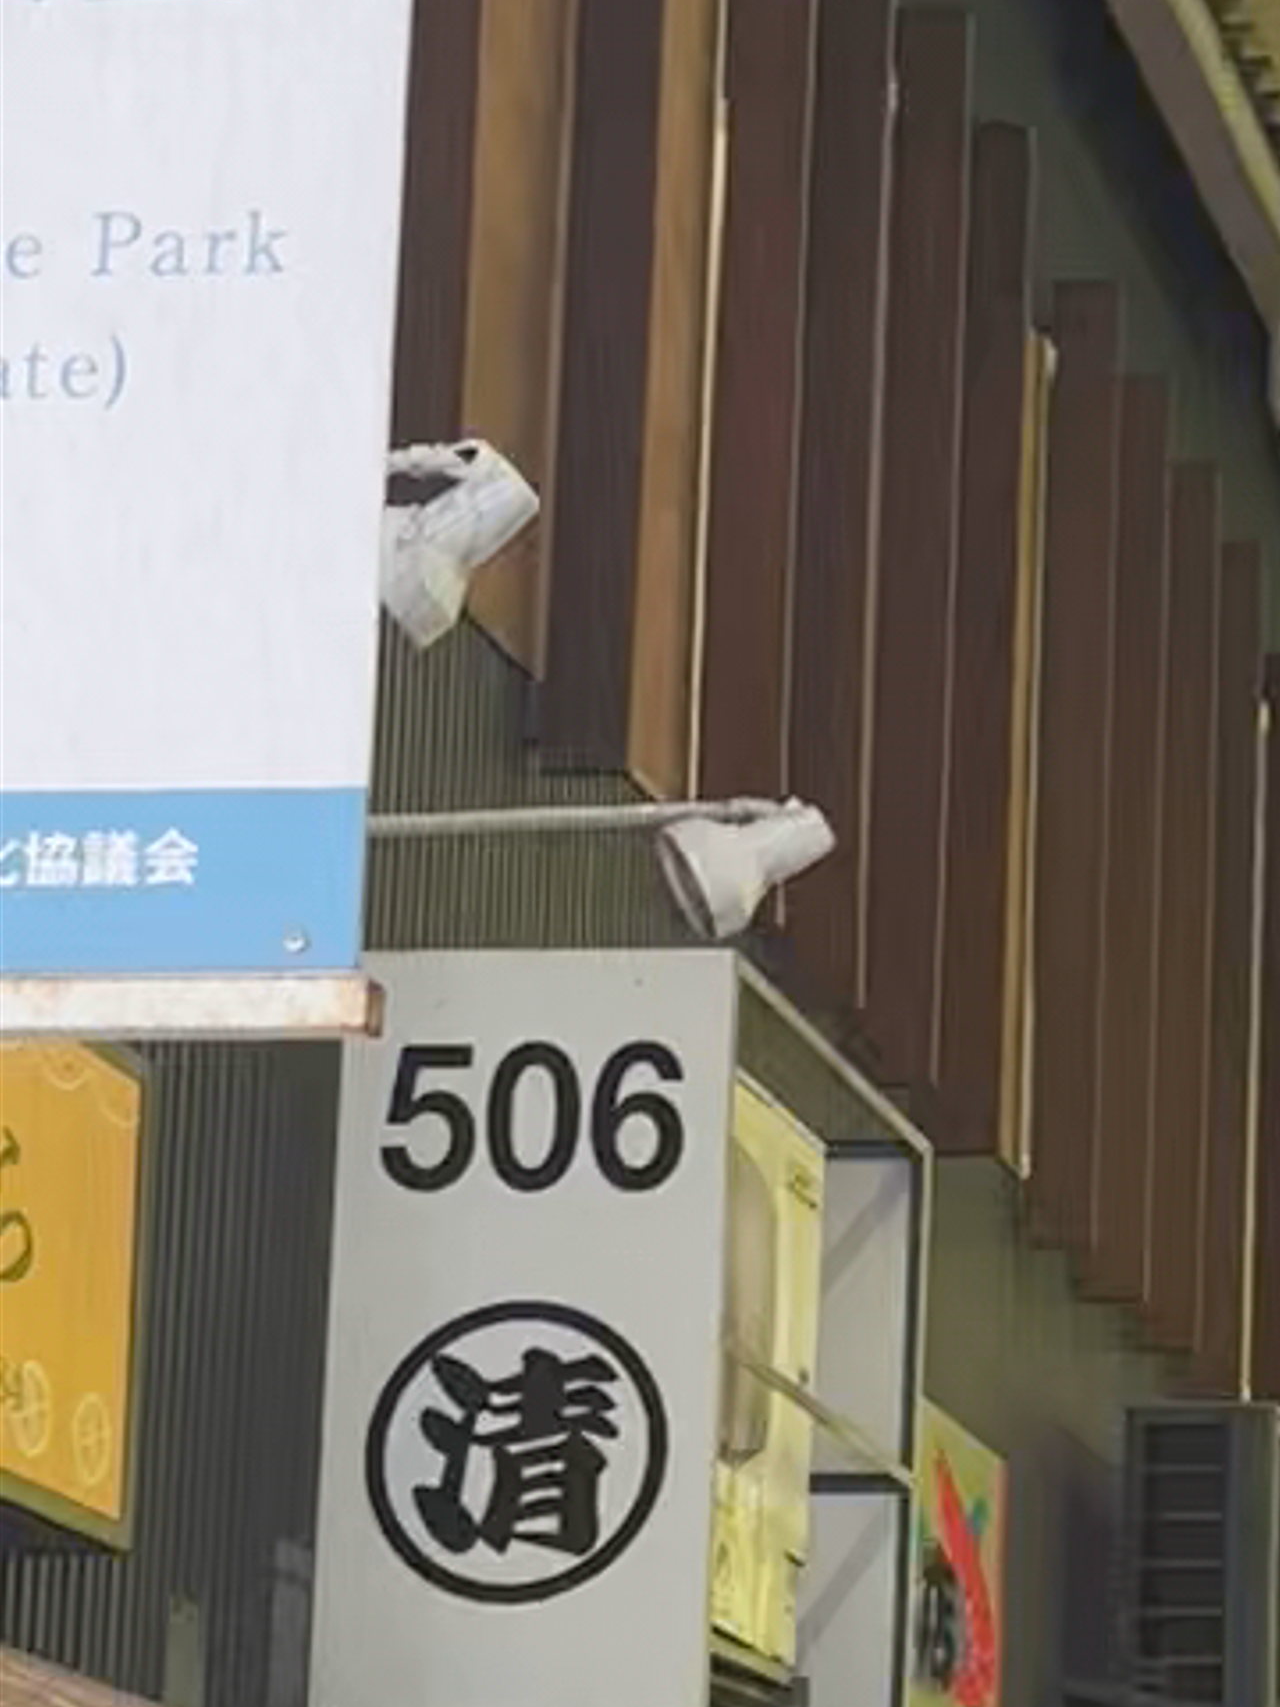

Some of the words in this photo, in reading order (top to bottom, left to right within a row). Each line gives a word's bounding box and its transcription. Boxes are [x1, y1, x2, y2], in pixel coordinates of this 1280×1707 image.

[91, 208, 287, 278] Park
[380, 1041, 684, 1192] 506
[408, 1343, 622, 1559] 清
